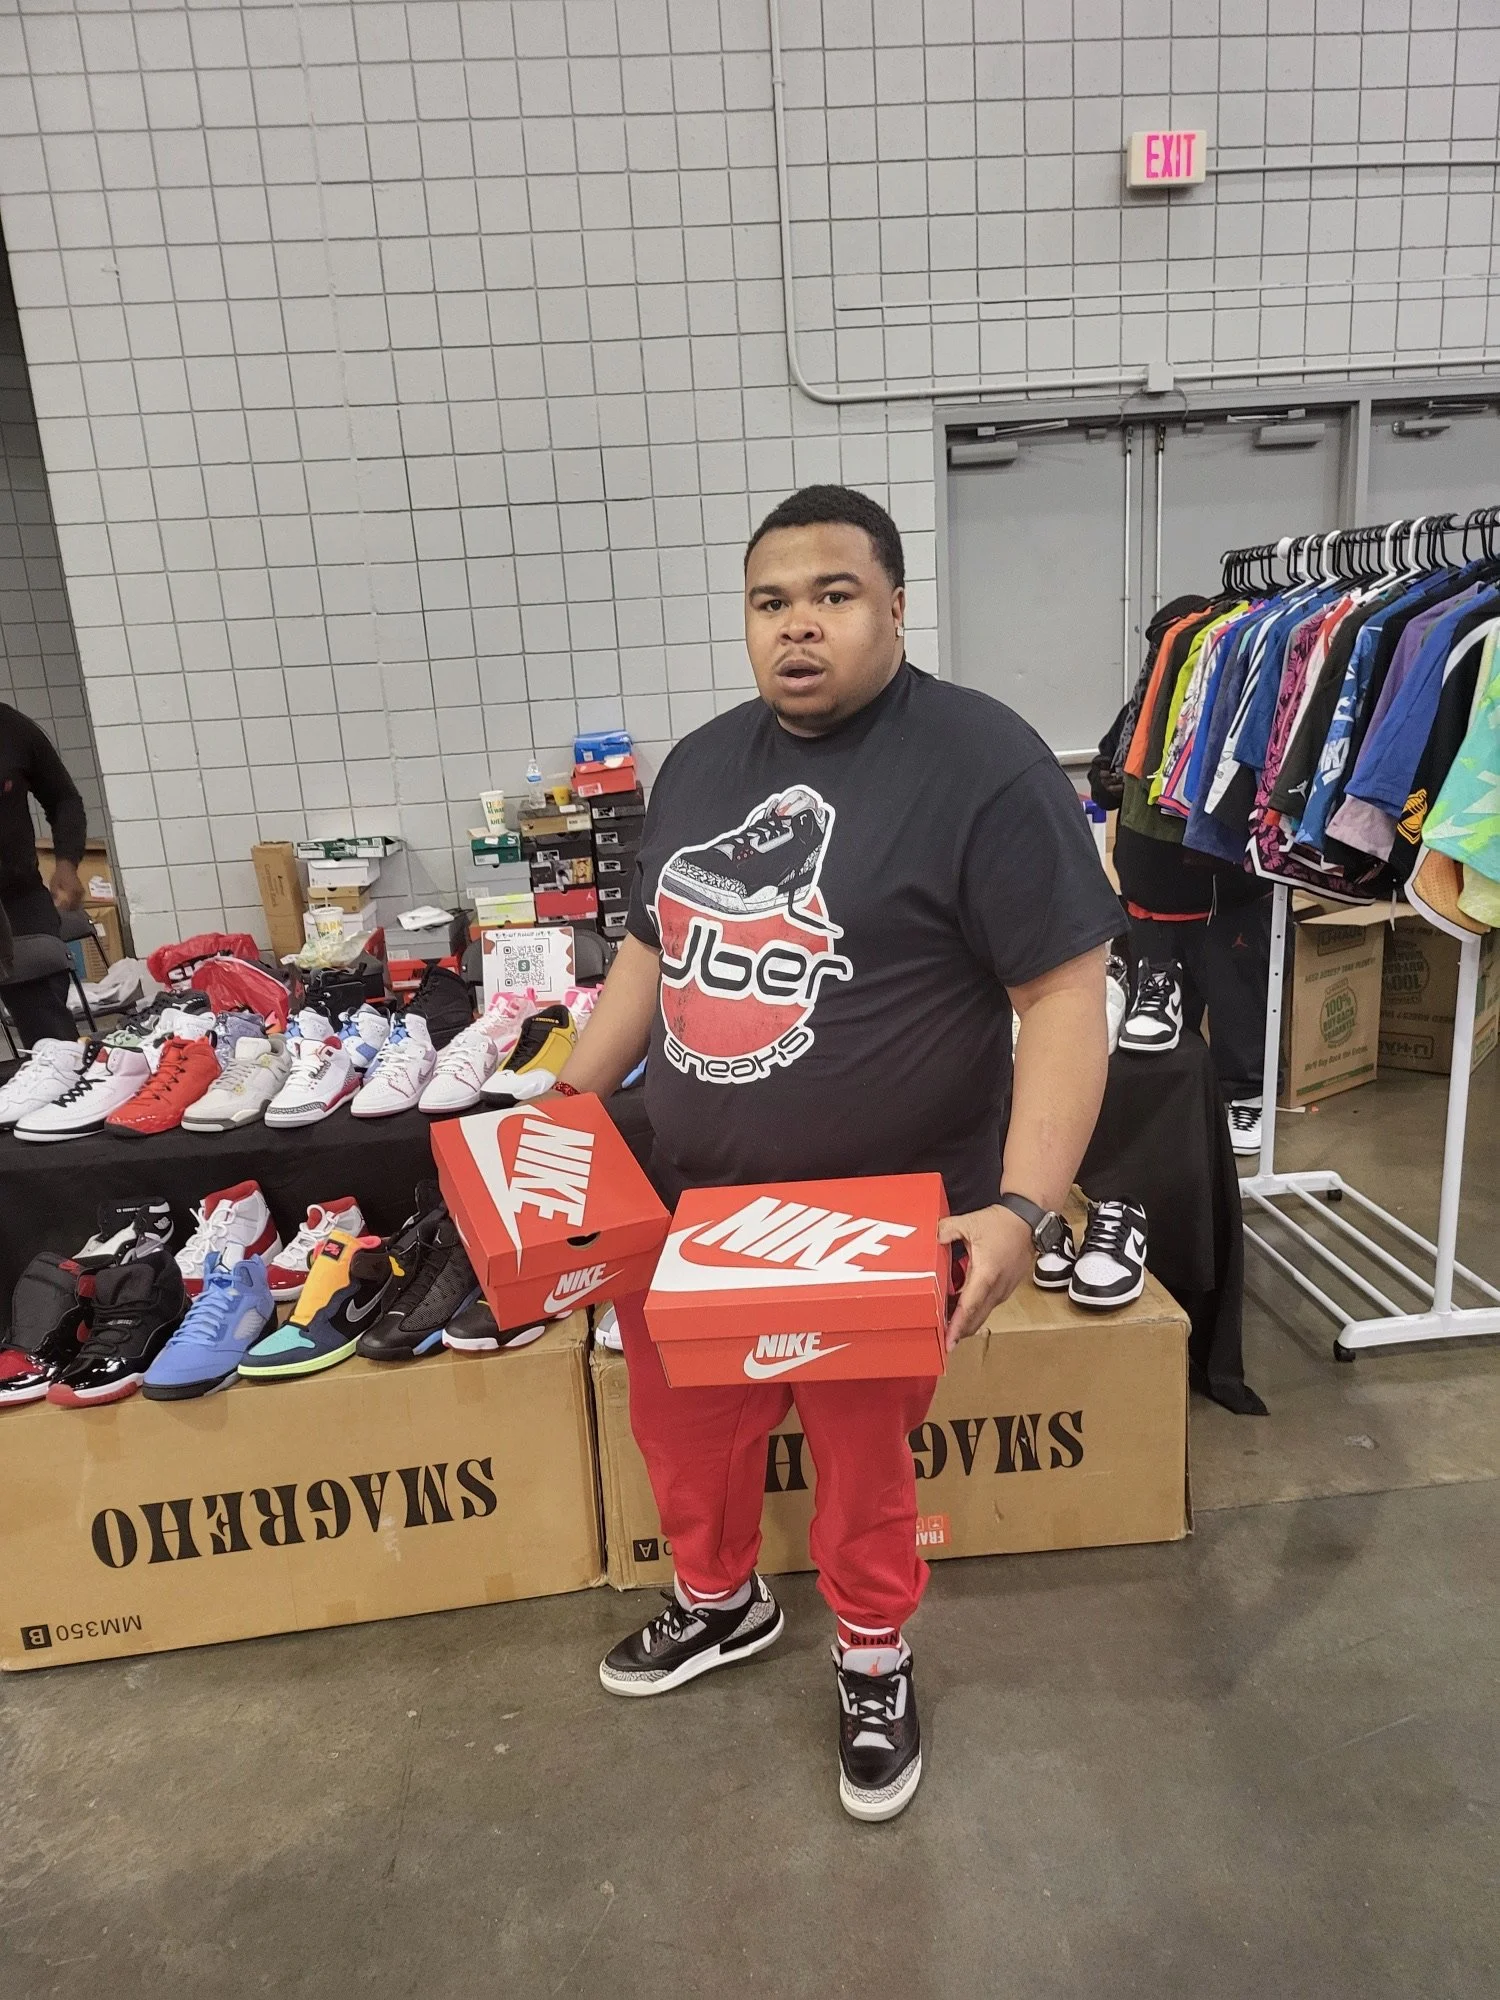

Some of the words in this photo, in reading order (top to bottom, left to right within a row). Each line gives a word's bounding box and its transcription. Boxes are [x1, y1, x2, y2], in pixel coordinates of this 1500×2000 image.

[1146, 133, 1196, 179] EXIT
[649, 909, 848, 1000] Uber
[1325, 992, 1352, 1017] 100%
[508, 1117, 594, 1228] NIKE
[693, 1196, 917, 1272] NIKE
[555, 1263, 607, 1293] NIKE
[756, 1332, 822, 1358] NIKE
[91, 1456, 499, 1568] SMAGREHO
[639, 1542, 653, 1558] A
[28, 1627, 45, 1646] B
[56, 1614, 142, 1641] MM350
